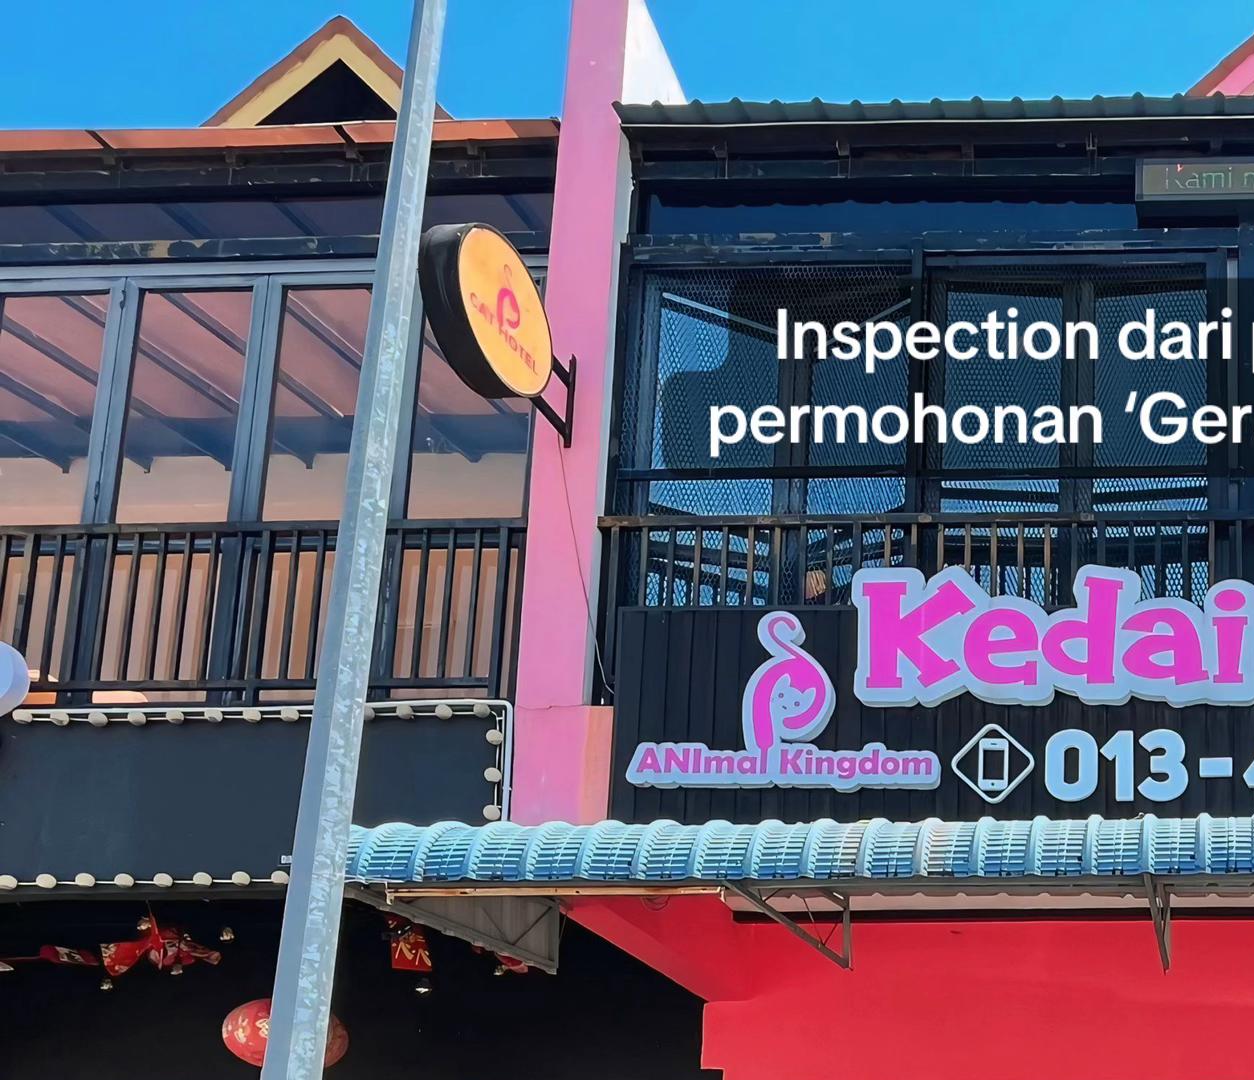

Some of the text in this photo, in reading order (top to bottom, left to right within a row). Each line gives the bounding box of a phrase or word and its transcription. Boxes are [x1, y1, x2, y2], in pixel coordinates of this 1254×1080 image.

[469, 292, 538, 375] CAT HOTEL
[858, 571, 1252, 692] Kedai
[779, 745, 934, 780] Kingdom
